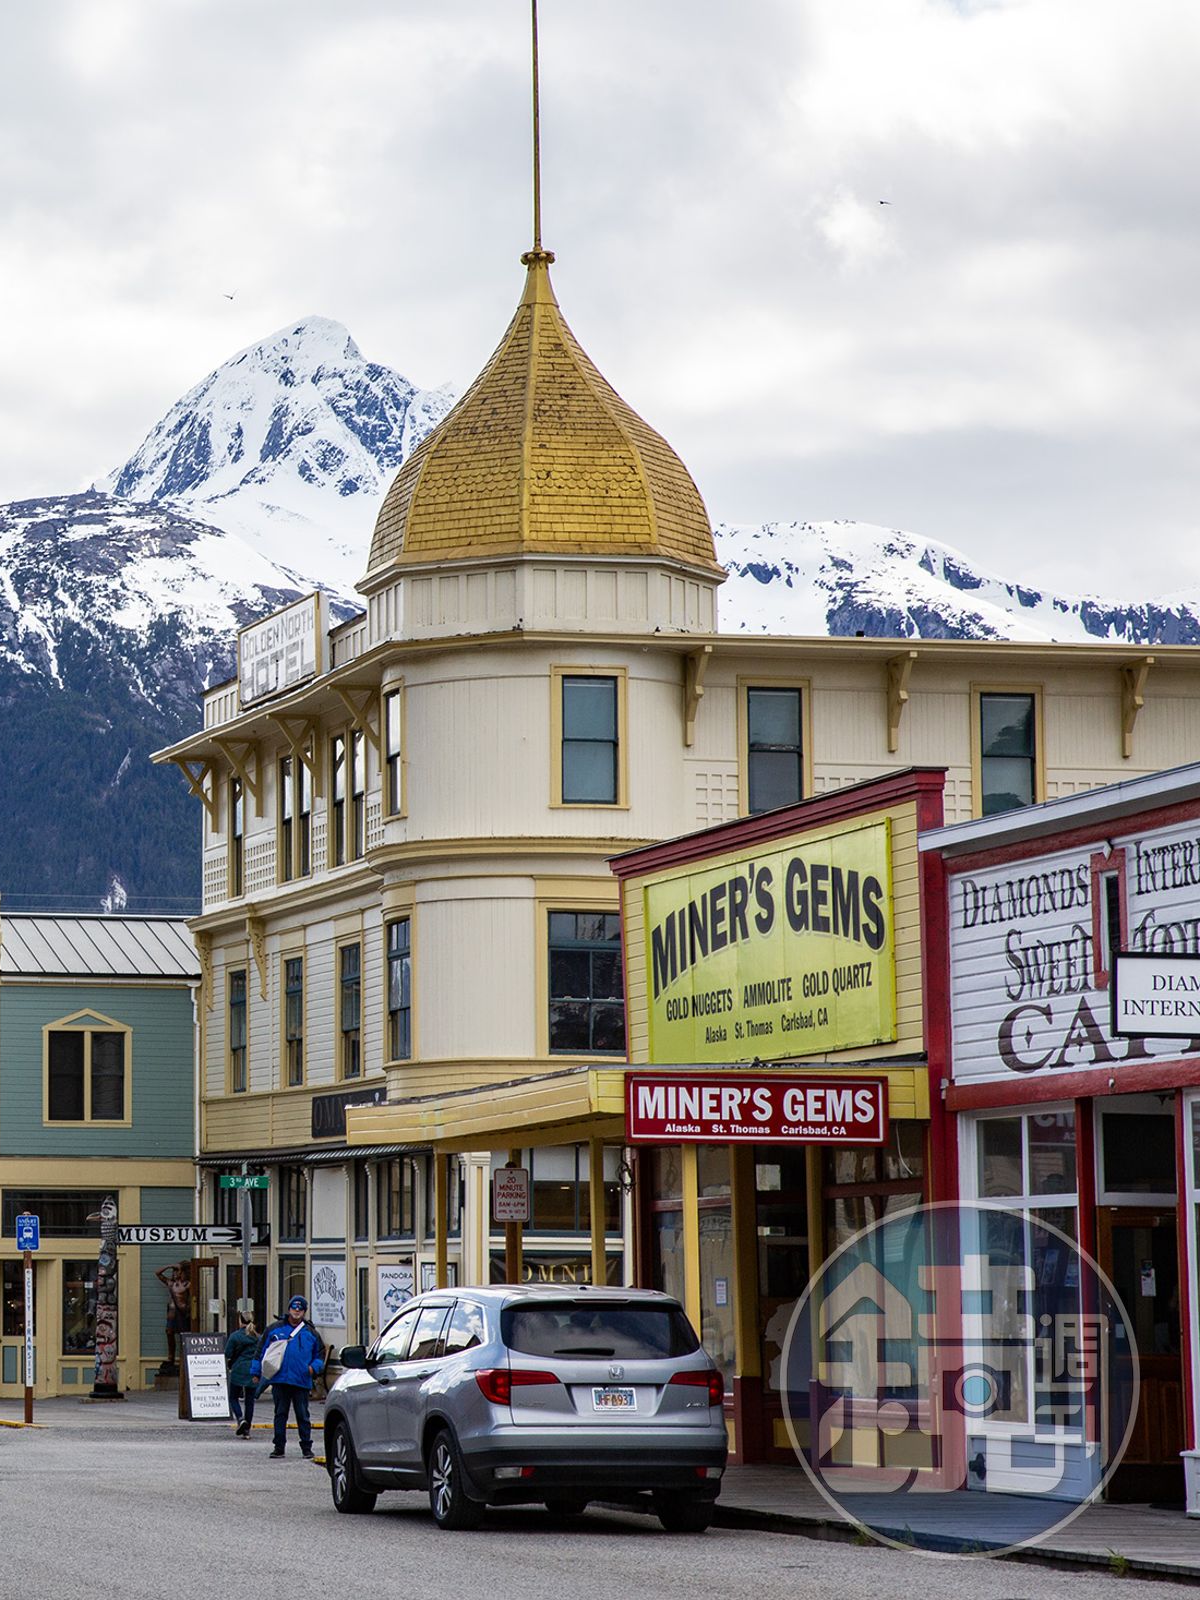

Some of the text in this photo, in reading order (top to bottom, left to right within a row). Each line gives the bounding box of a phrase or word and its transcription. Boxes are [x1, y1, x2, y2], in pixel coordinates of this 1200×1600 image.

[242, 606, 314, 661] GOLDEN NORTH
[240, 639, 315, 703] HOTEL
[1134, 837, 1200, 895] INTER
[961, 863, 1089, 929] DIAMONDS
[651, 857, 886, 999] MINER'S GEMS
[666, 961, 873, 1022] GOLD NUGGETS AMMOLITE GOLD QUARTZ
[705, 1007, 829, 1044] Alaska St. Thomas Carlsbad, CA
[637, 1086, 875, 1124] MINER'S GEMS
[664, 1123, 847, 1136] Alaska St. Thomas Carlsbad, CA
[244, 1177, 259, 1187] AVE
[506, 1176, 516, 1184] 20
[118, 1228, 208, 1242] MUSEUM
